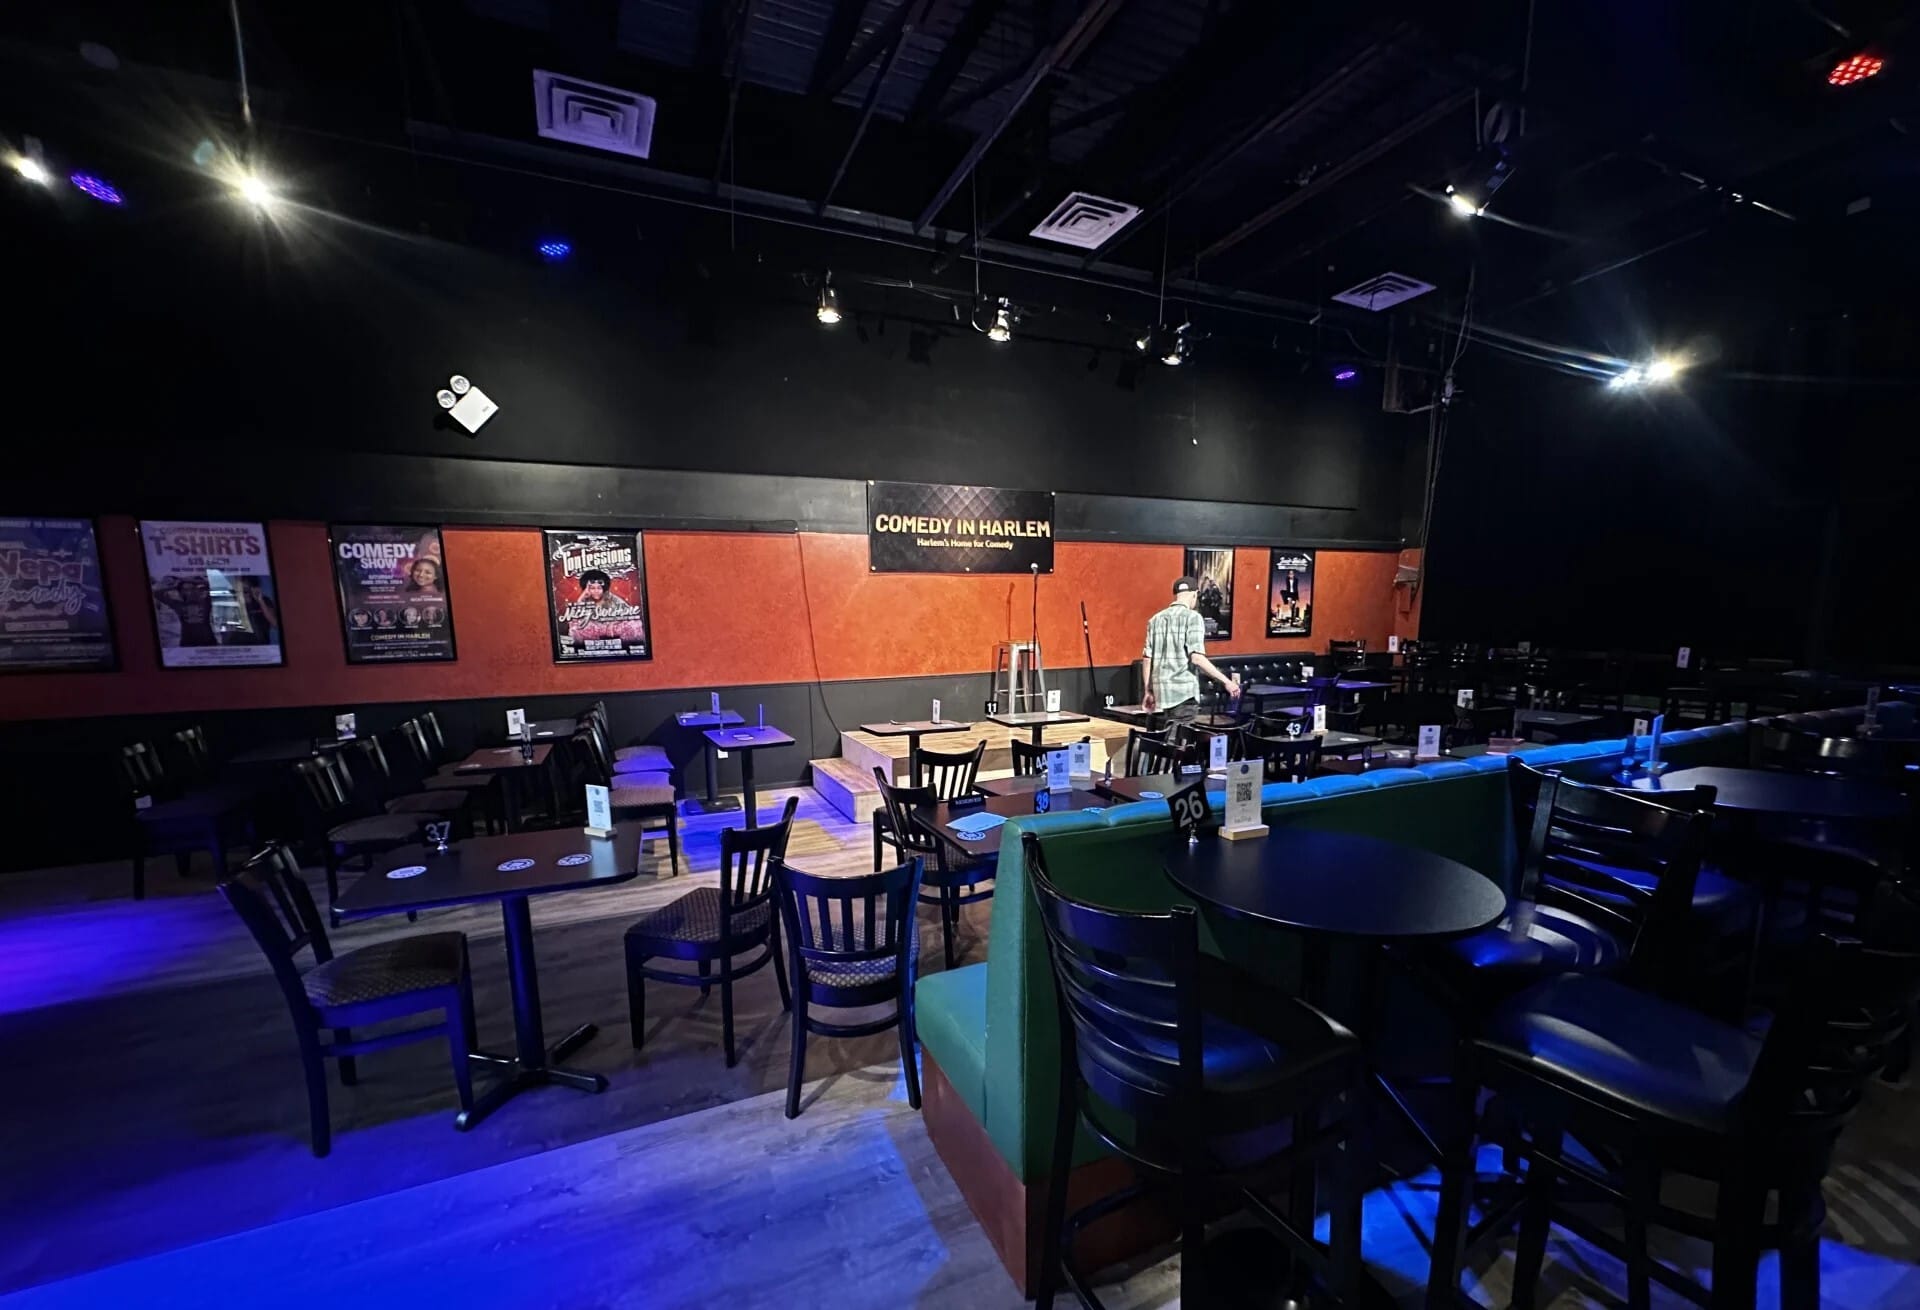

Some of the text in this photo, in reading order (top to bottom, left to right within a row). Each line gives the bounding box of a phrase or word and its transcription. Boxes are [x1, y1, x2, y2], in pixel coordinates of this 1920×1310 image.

[875, 513, 1051, 538] COMEDY IN HARLEM
[149, 535, 260, 556] T-SHIRTS
[339, 543, 416, 559] COMEDY
[917, 538, 1014, 551] Harlem's Home for Comedy
[360, 558, 398, 569] SHOW
[987, 702, 997, 712] 11
[1105, 695, 1114, 704] 10
[1285, 721, 1301, 735] 43
[1036, 791, 1049, 812] 38
[1175, 790, 1204, 828] 26
[424, 819, 451, 842] 37
